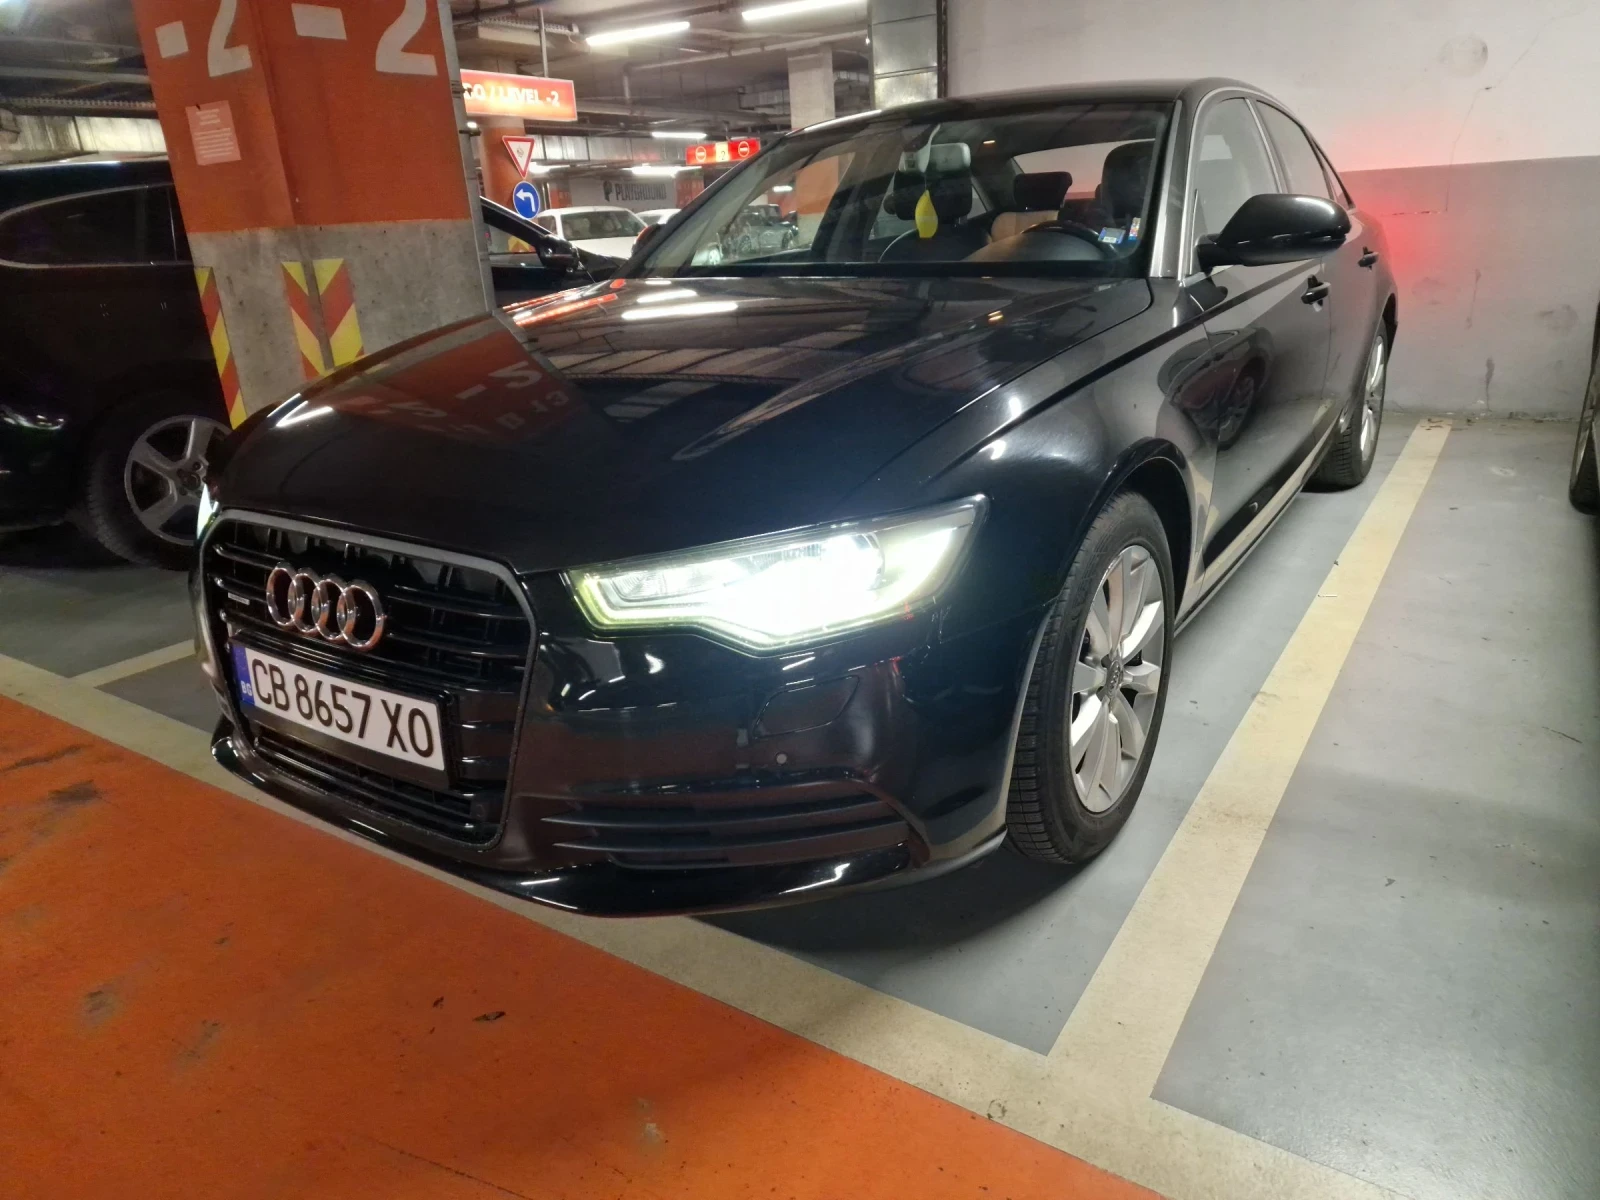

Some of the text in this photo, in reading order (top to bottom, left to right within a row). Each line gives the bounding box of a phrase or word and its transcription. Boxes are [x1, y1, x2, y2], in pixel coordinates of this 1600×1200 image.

[499, 86, 543, 105] LEVEL
[546, 90, 560, 107] -2
[614, 183, 667, 201] PLAYGROUND
[240, 680, 253, 697] BG
[251, 658, 434, 758] CB 8657 XO
